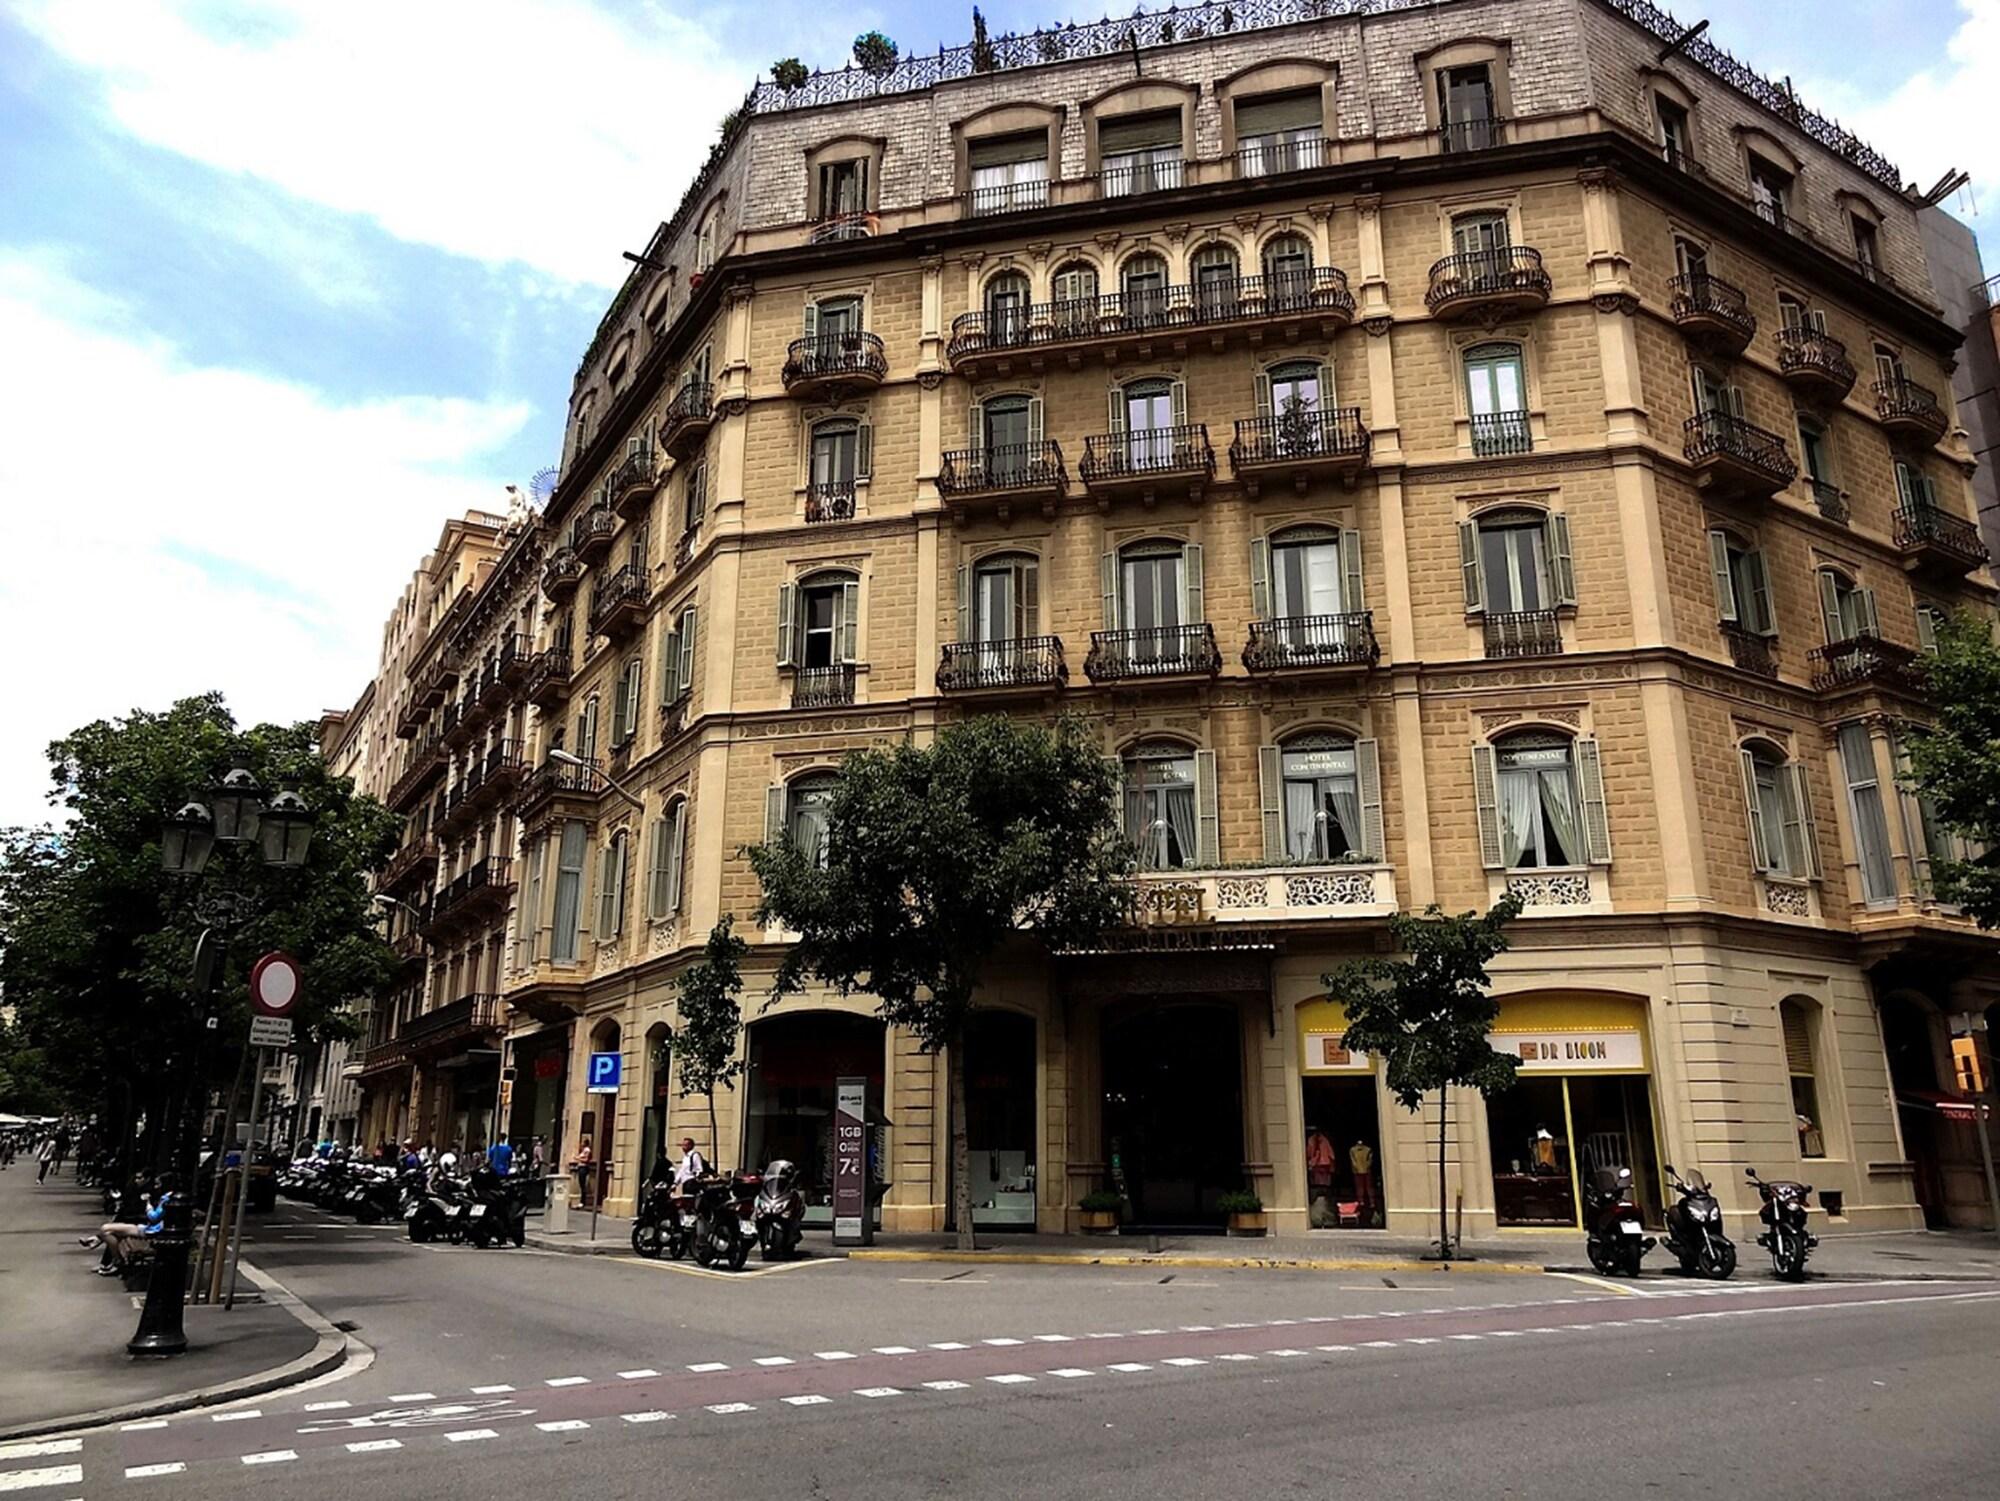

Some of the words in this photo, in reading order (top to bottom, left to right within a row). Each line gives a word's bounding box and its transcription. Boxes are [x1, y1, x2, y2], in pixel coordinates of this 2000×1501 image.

[1304, 752, 1331, 761] HOTEL
[1541, 1042, 1558, 1059] DR
[1566, 1041, 1606, 1059] BLOOM
[595, 1057, 613, 1083] P
[840, 1127, 861, 1137] 1GB
